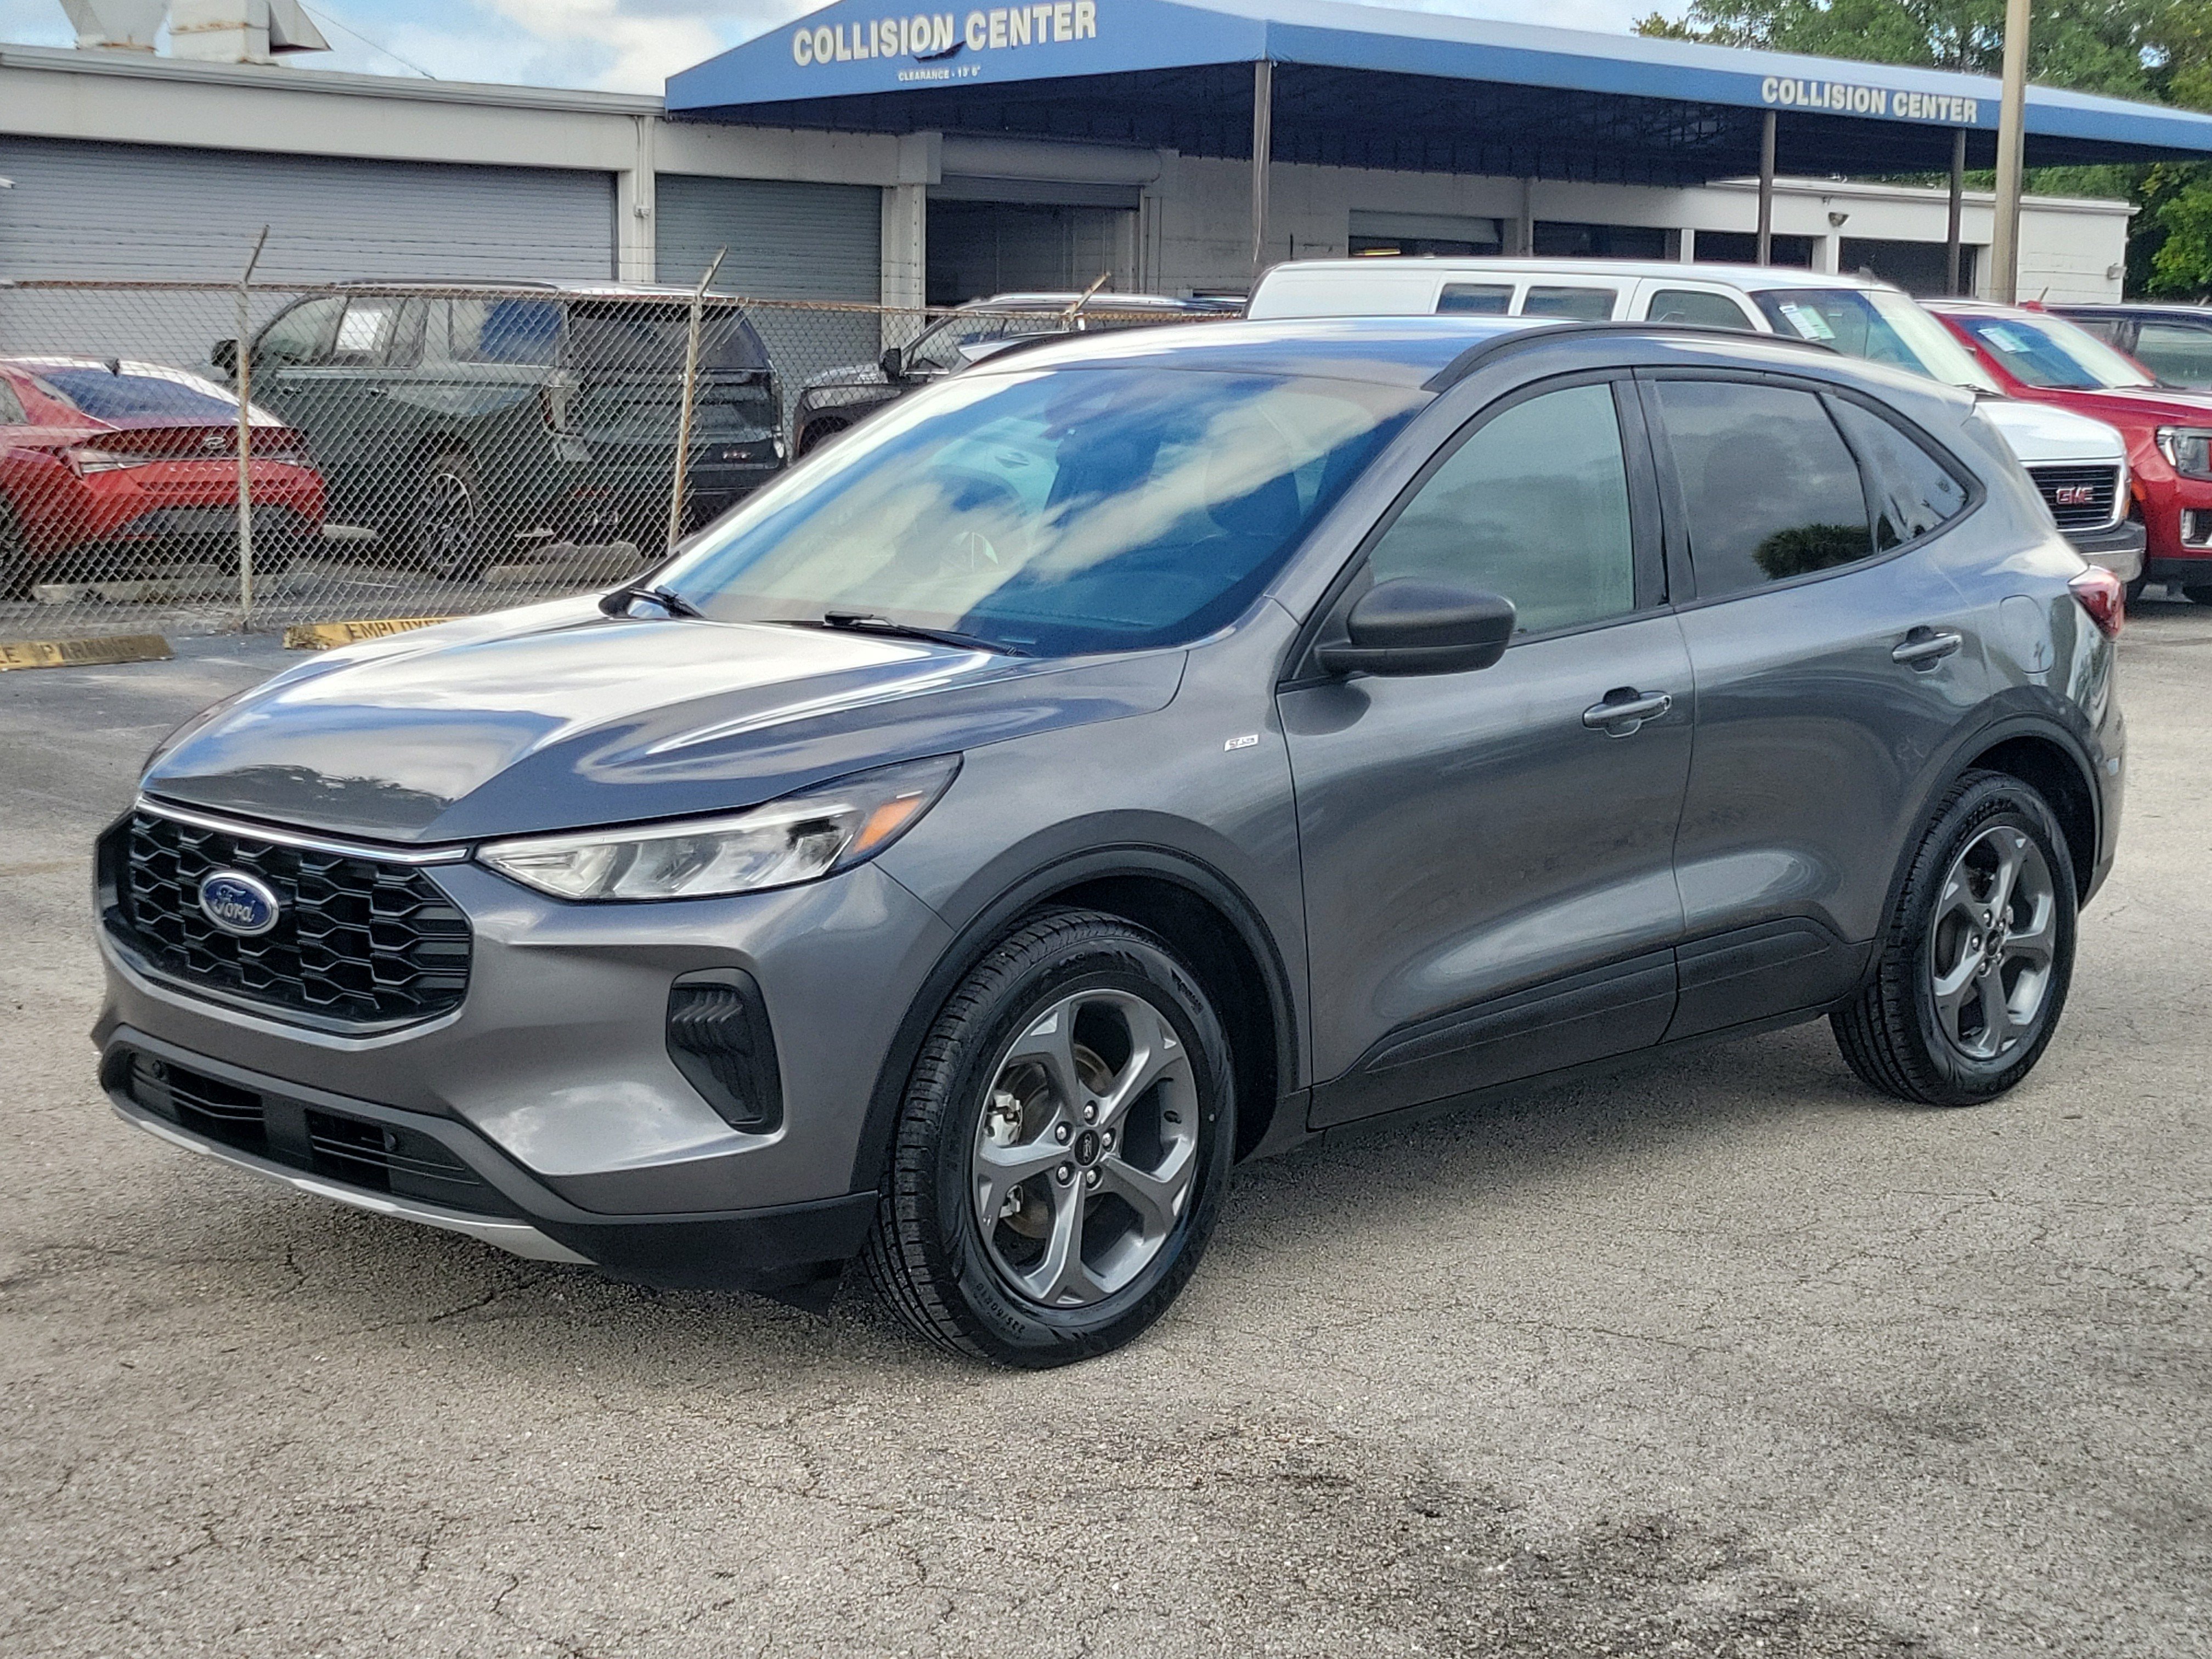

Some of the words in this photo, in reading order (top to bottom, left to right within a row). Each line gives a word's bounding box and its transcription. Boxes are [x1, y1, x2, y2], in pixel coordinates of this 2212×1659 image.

[794, 13, 955, 66] COLLISION
[966, 1, 1096, 51] CENTER
[898, 69, 950, 81] CLEARANCE
[1762, 77, 1887, 114] COLLISION
[1893, 92, 1977, 123] CENTER
[2056, 487, 2094, 505] GMC
[208, 884, 256, 923] Ford
